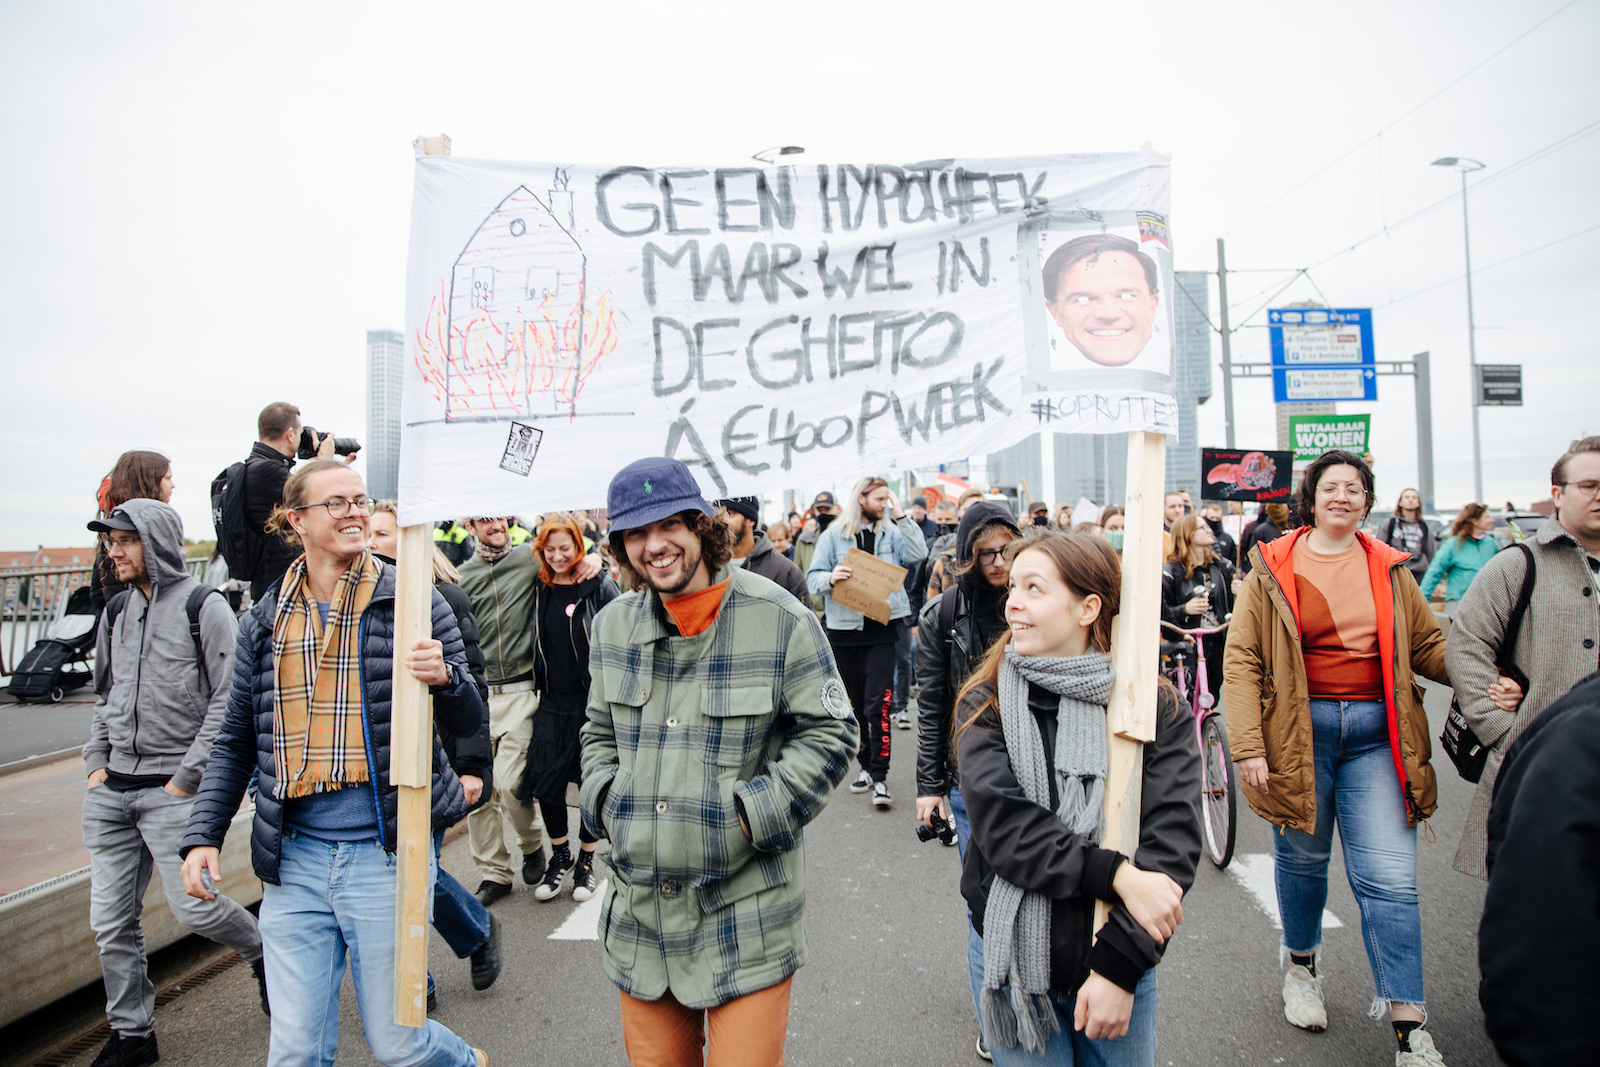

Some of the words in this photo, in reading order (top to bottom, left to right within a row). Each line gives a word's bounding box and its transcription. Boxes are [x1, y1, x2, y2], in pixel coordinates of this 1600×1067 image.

[595, 164, 796, 238] GEEN
[818, 159, 1048, 232] HYPOTHEEK
[643, 240, 808, 305] MAAR
[815, 240, 912, 298] WEL
[937, 237, 991, 295] IN
[653, 316, 740, 397] DE
[1295, 421, 1365, 433] BETAALBAAR
[1295, 431, 1365, 447] WONEN
[1295, 447, 1321, 455] VOOR
